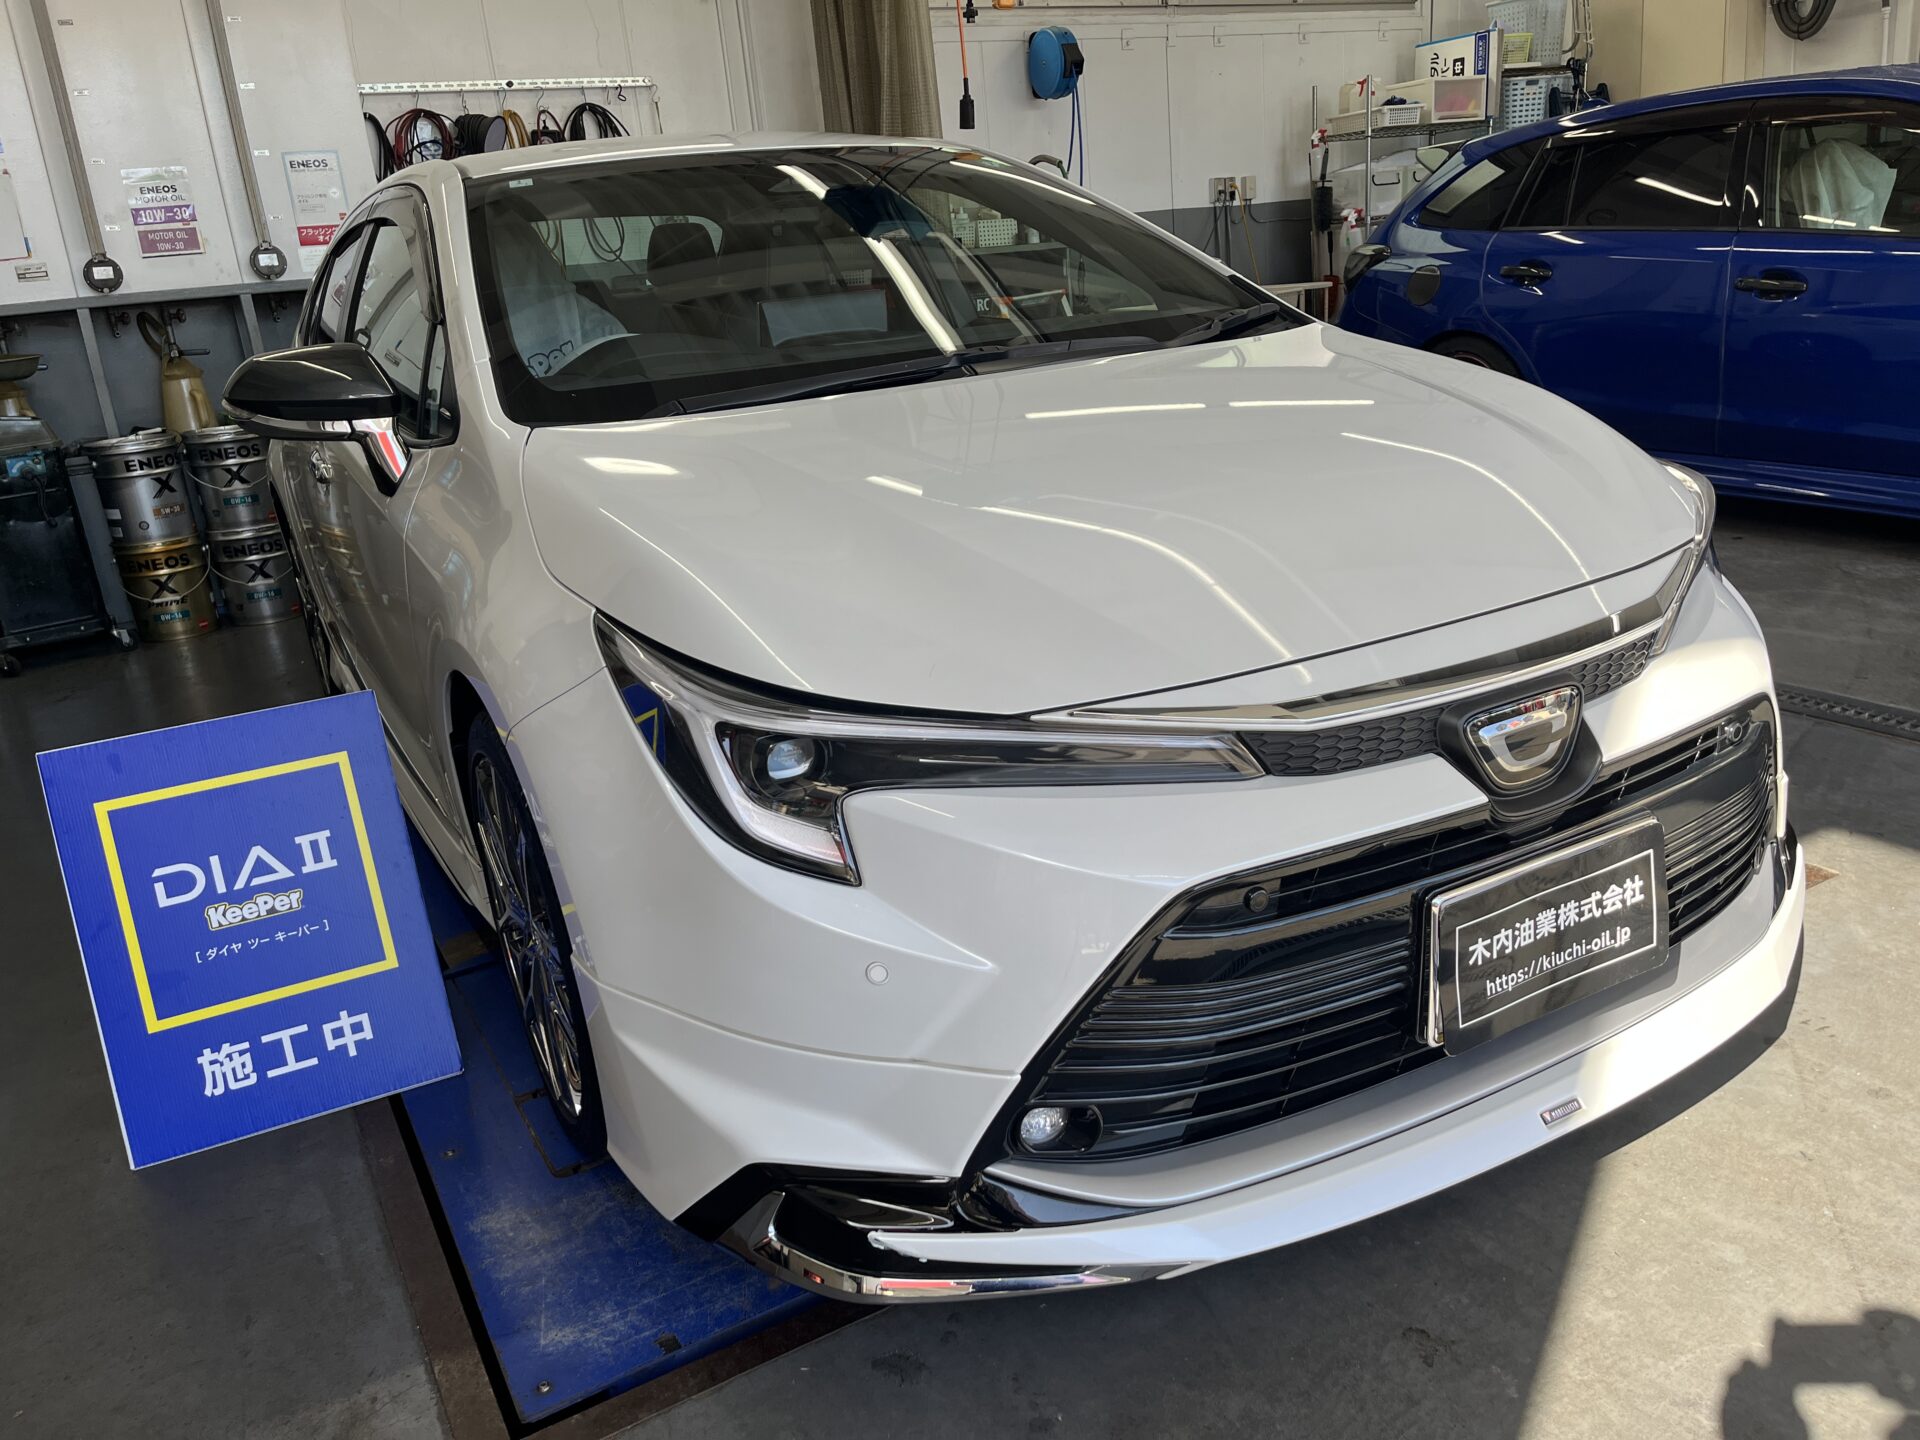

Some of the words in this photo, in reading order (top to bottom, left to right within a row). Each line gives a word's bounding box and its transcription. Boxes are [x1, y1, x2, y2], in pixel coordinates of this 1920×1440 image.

[288, 159, 329, 169] ENEOS
[139, 184, 178, 195] ENEOS
[135, 195, 170, 204] MOTOR
[138, 207, 190, 223] 10W-30
[147, 231, 175, 240] MOTOR
[175, 230, 189, 239] OIL
[156, 242, 185, 251] 10W-30
[198, 443, 261, 462] ENEOS
[222, 539, 283, 559] ENEOS
[126, 553, 190, 573] ENEOS
[205, 888, 304, 931] KeePer
[1468, 875, 1645, 966] 木内油業株式会社
[1485, 926, 1631, 998] https://kiuchi-oil.jp
[197, 1010, 374, 1097] 施工中
